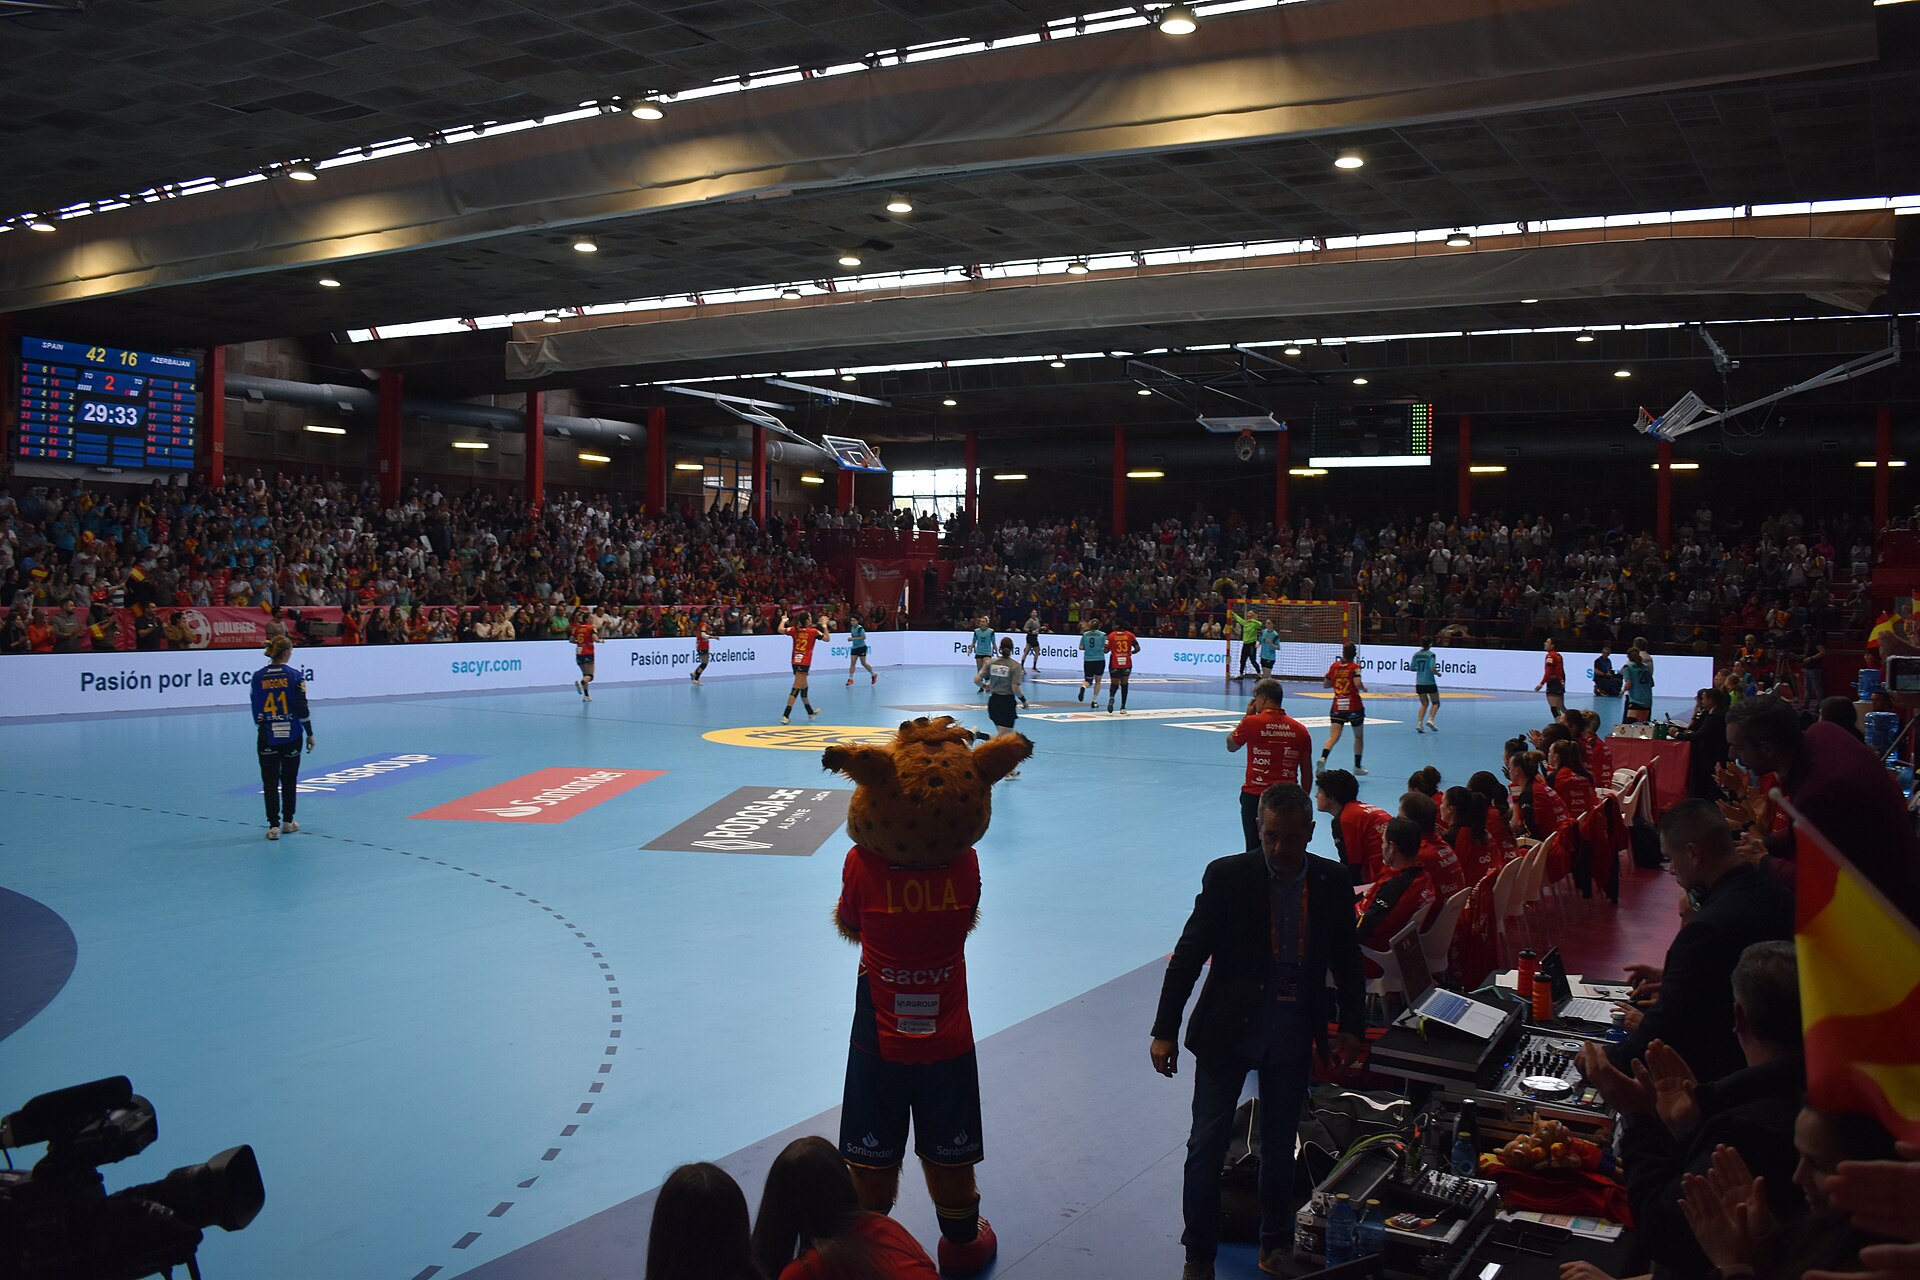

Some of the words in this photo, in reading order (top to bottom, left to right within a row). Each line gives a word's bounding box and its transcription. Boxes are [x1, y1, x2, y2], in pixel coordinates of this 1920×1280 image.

[42, 341, 64, 350] SPAIN
[85, 347, 106, 362] 42
[120, 351, 138, 366] 16
[150, 357, 191, 367] AZERBAIJAN
[104, 375, 115, 391] 2
[134, 378, 143, 386] TO
[83, 403, 138, 426] 29:33
[213, 621, 257, 636] QUALIFIERS
[795, 639, 808, 651] 22
[1089, 637, 1096, 648] 9
[1116, 640, 1129, 653] 33
[631, 651, 668, 666] Pasión
[672, 653, 690, 668] por
[709, 648, 755, 663] xcelencia
[452, 658, 521, 677] sacyr.com
[1377, 660, 1397, 673] por
[81, 670, 151, 691] Pasión
[159, 672, 192, 693] por
[198, 668, 213, 687] la
[261, 677, 289, 689] WIGGINS
[1639, 670, 1649, 684] 20
[1335, 679, 1350, 695] 52
[263, 690, 289, 717] 41
[1252, 757, 1271, 766] AON
[535, 770, 628, 807] Santander
[703, 798, 795, 838] RODOSA
[776, 808, 811, 829] ALPINE
[886, 878, 960, 913] LOLA
[880, 966, 956, 986] sacyr
[846, 1142, 894, 1159] Santander
